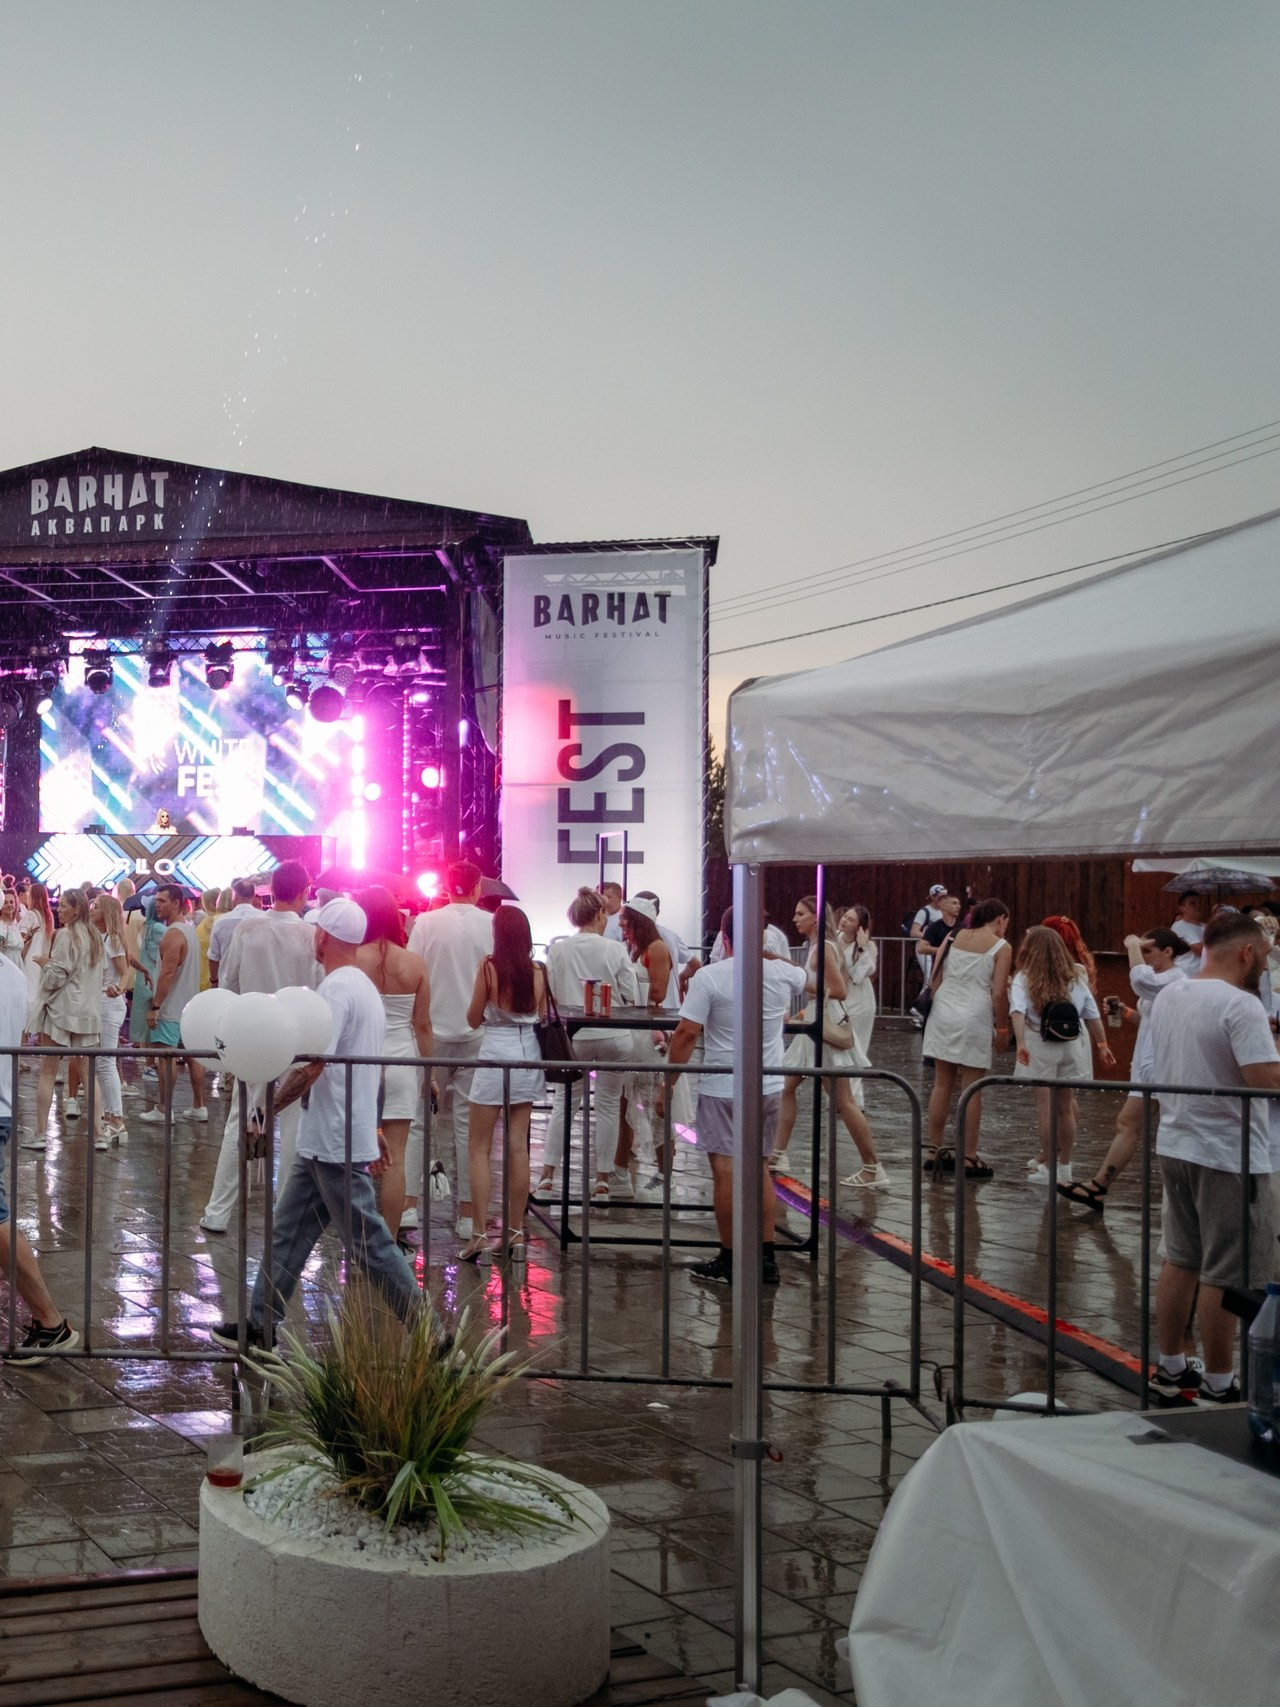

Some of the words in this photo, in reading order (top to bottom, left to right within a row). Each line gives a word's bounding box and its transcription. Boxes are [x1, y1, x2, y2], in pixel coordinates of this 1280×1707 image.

[30, 472, 169, 515] BARHAT
[30, 513, 165, 536] АКВАПАРК
[533, 590, 672, 628] BARHAT
[544, 632, 586, 640] MUSIC
[594, 631, 660, 639] FESTIVAL
[556, 699, 646, 865] FEST
